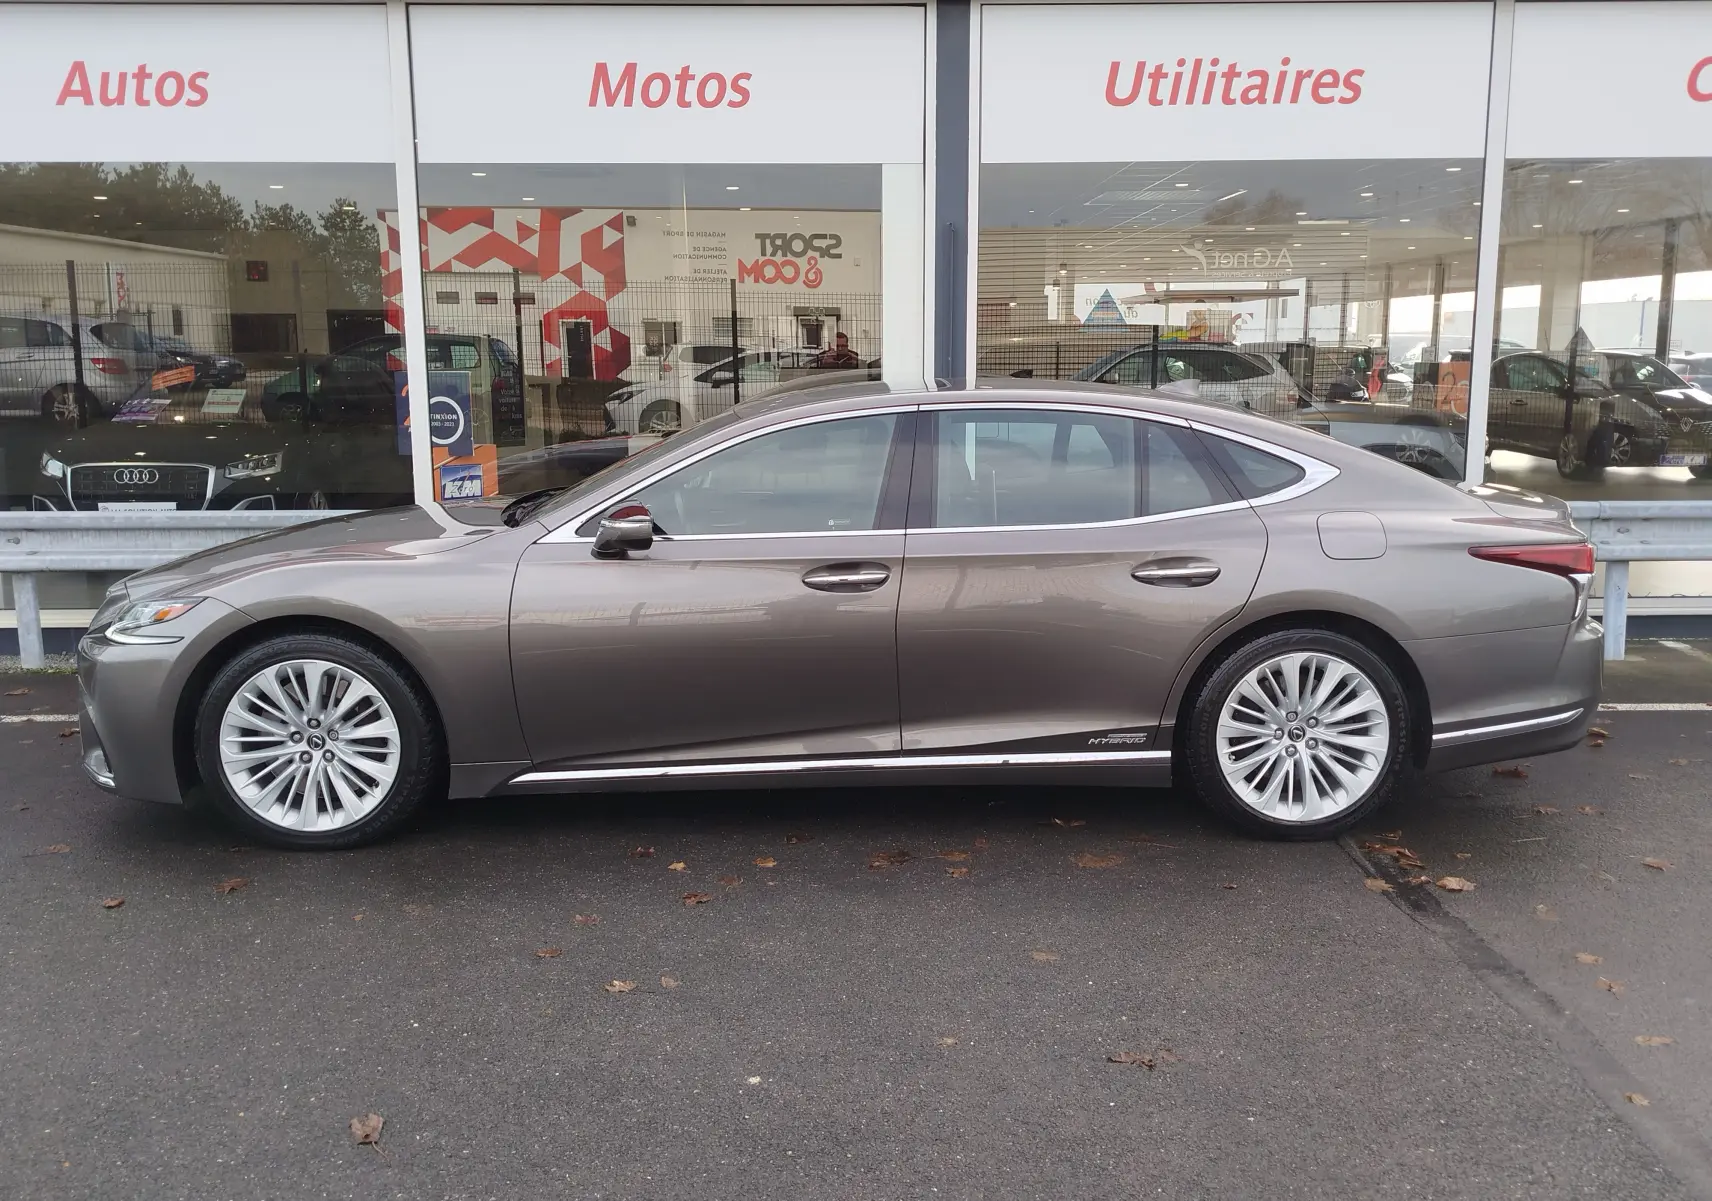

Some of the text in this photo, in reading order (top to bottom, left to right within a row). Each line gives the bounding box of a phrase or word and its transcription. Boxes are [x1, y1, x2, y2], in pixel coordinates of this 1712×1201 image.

[56, 61, 209, 107] Autos
[588, 62, 752, 108] Motos
[1105, 57, 1365, 107] Utilitaires
[444, 480, 482, 498] KM
[1088, 737, 1146, 745] HYBRID
